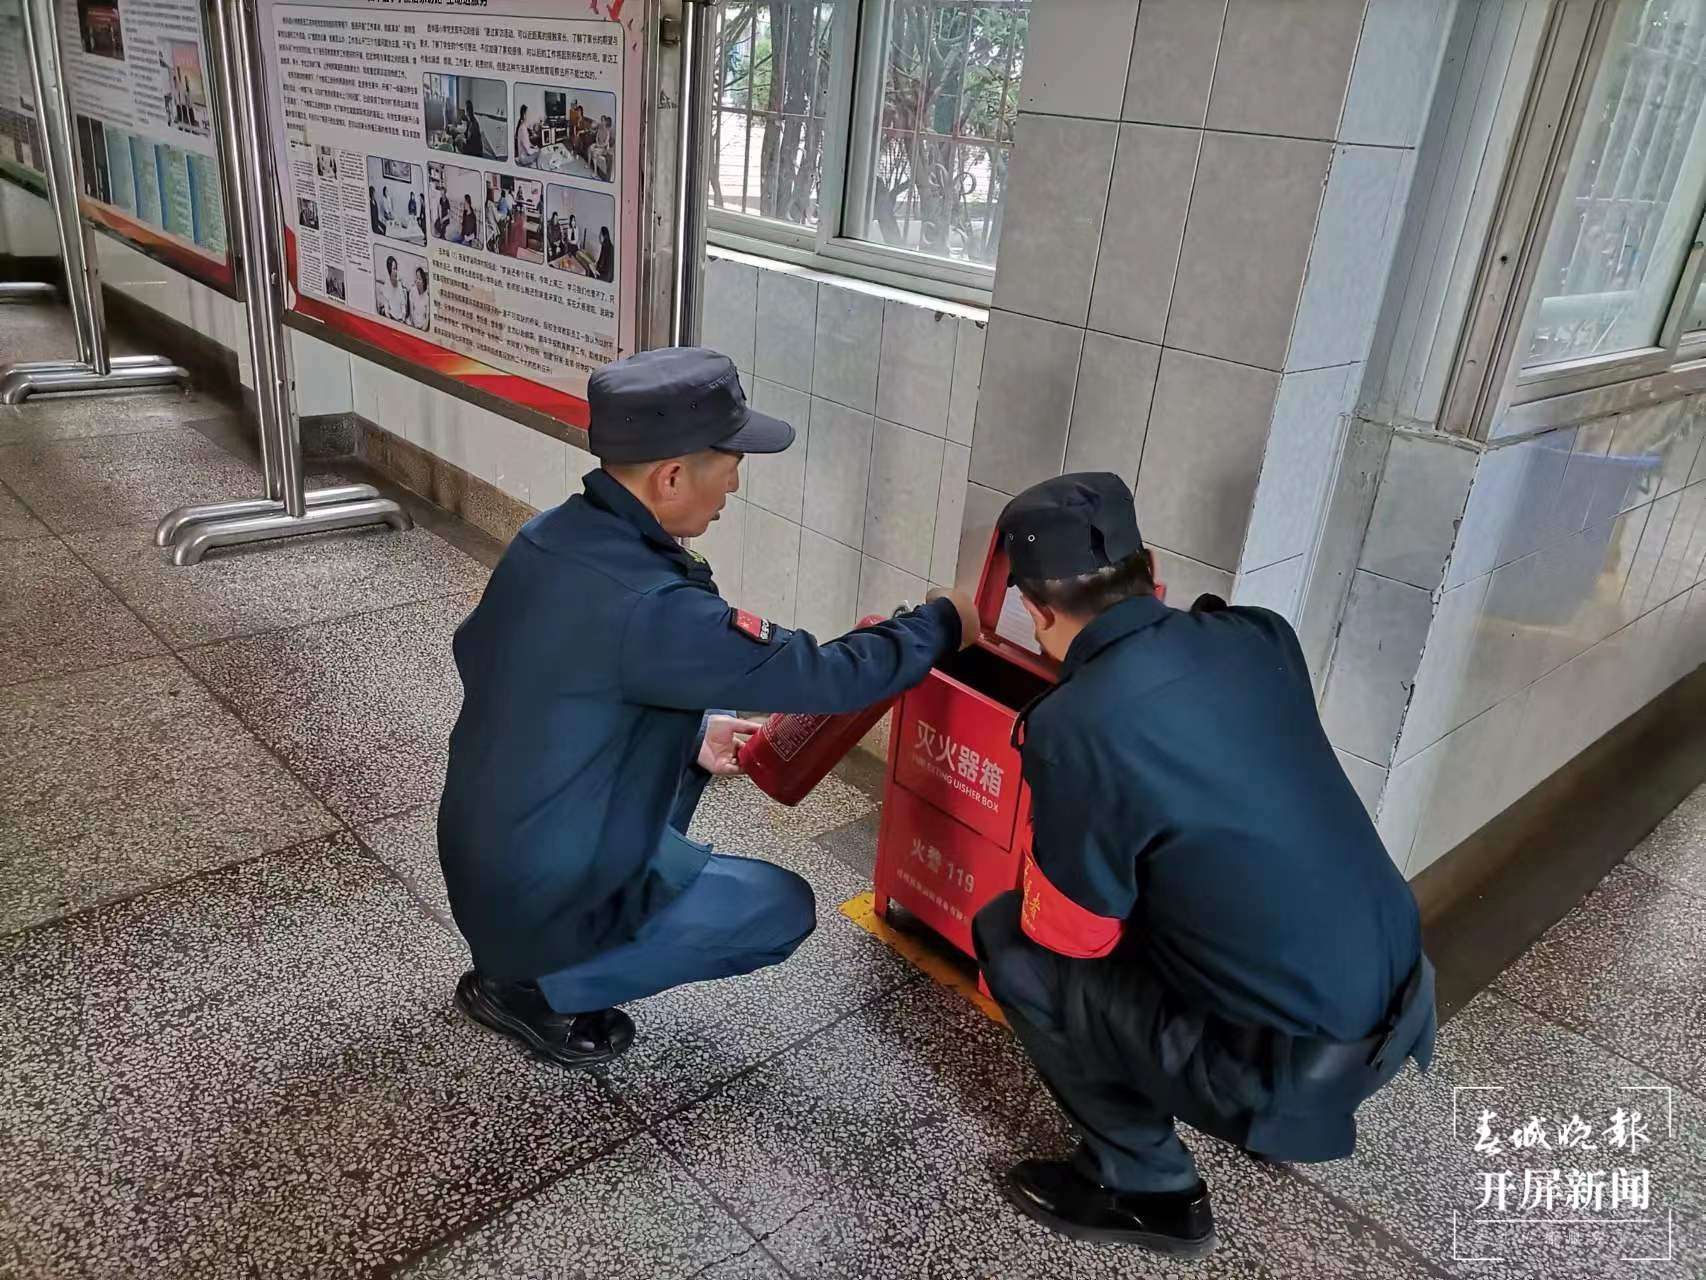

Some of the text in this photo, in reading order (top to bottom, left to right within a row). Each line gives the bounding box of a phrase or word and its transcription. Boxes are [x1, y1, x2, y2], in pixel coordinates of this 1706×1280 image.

[914, 719, 1004, 798] 灭火器箱
[953, 778, 981, 802] UISHER
[981, 795, 999, 813] BOX
[947, 863, 975, 894] 119
